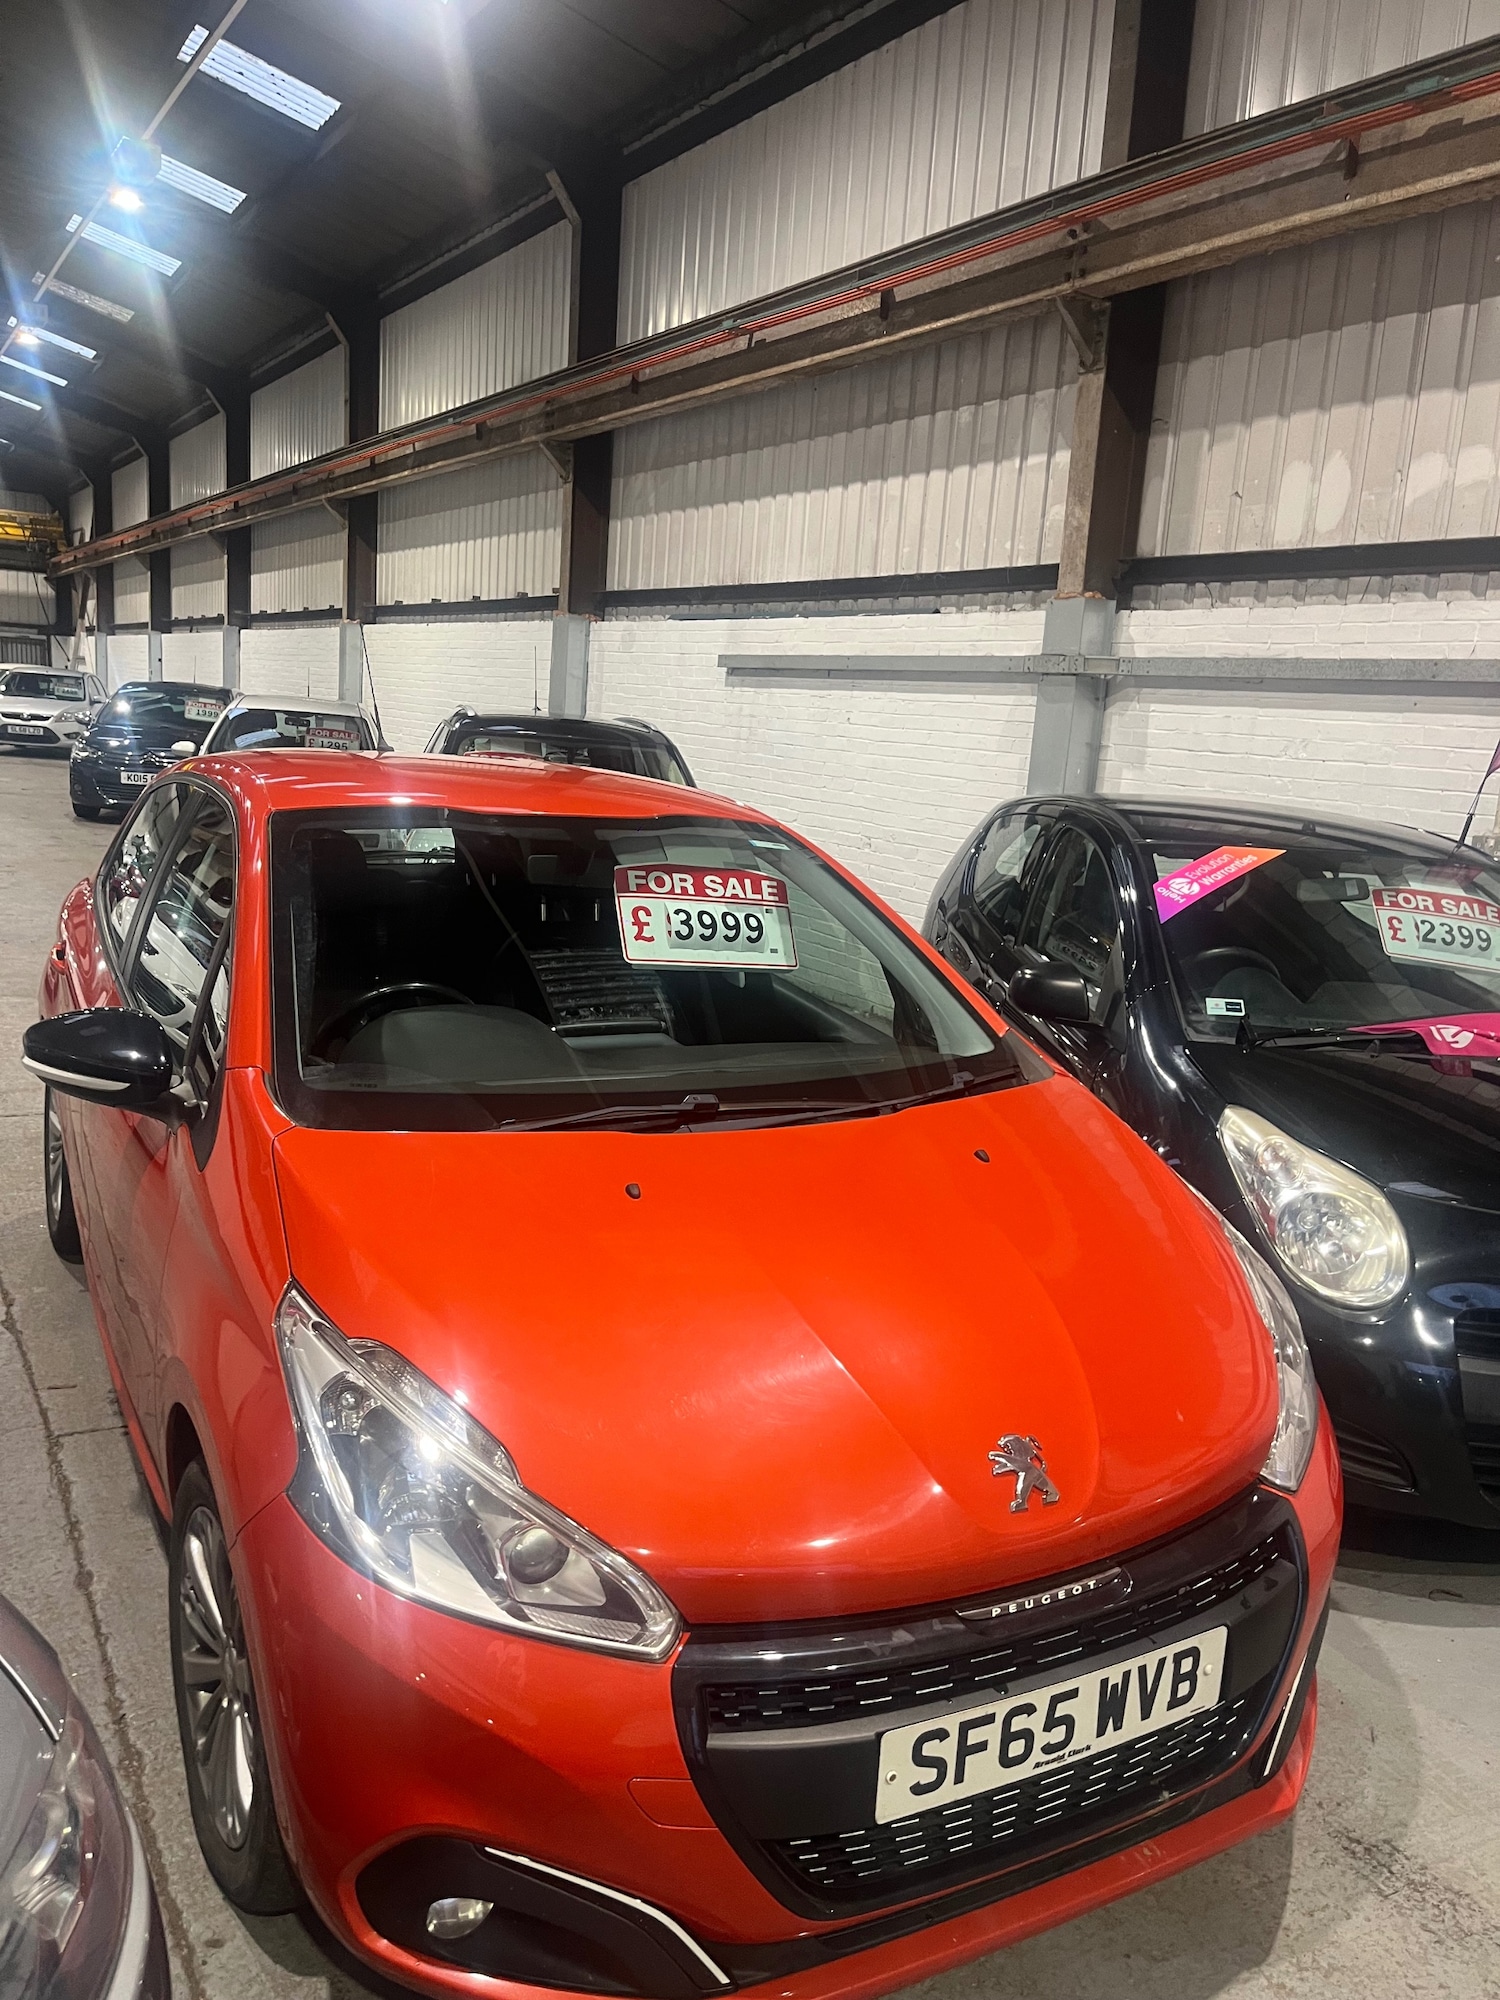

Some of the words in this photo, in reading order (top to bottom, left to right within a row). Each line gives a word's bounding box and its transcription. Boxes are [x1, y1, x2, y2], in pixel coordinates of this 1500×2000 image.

[196, 709, 219, 718] 1999
[309, 729, 330, 737] FOR
[332, 731, 357, 740] SALE
[320, 740, 348, 750] 1295
[1185, 853, 1235, 880] Evolution
[1198, 853, 1259, 887] Warranties
[626, 869, 696, 896] FOR
[702, 875, 780, 902] SALE
[1156, 886, 1188, 904] Hello
[1382, 890, 1436, 912] FOR
[1440, 898, 1500, 923] SALE
[630, 905, 656, 944] £
[672, 907, 765, 945] 3999
[1387, 915, 1407, 943] £
[1420, 919, 1492, 952] 2399
[991, 1580, 1097, 1618] PEUGEOT
[908, 1686, 1080, 1797] SF65
[1095, 1645, 1202, 1739] WVB
